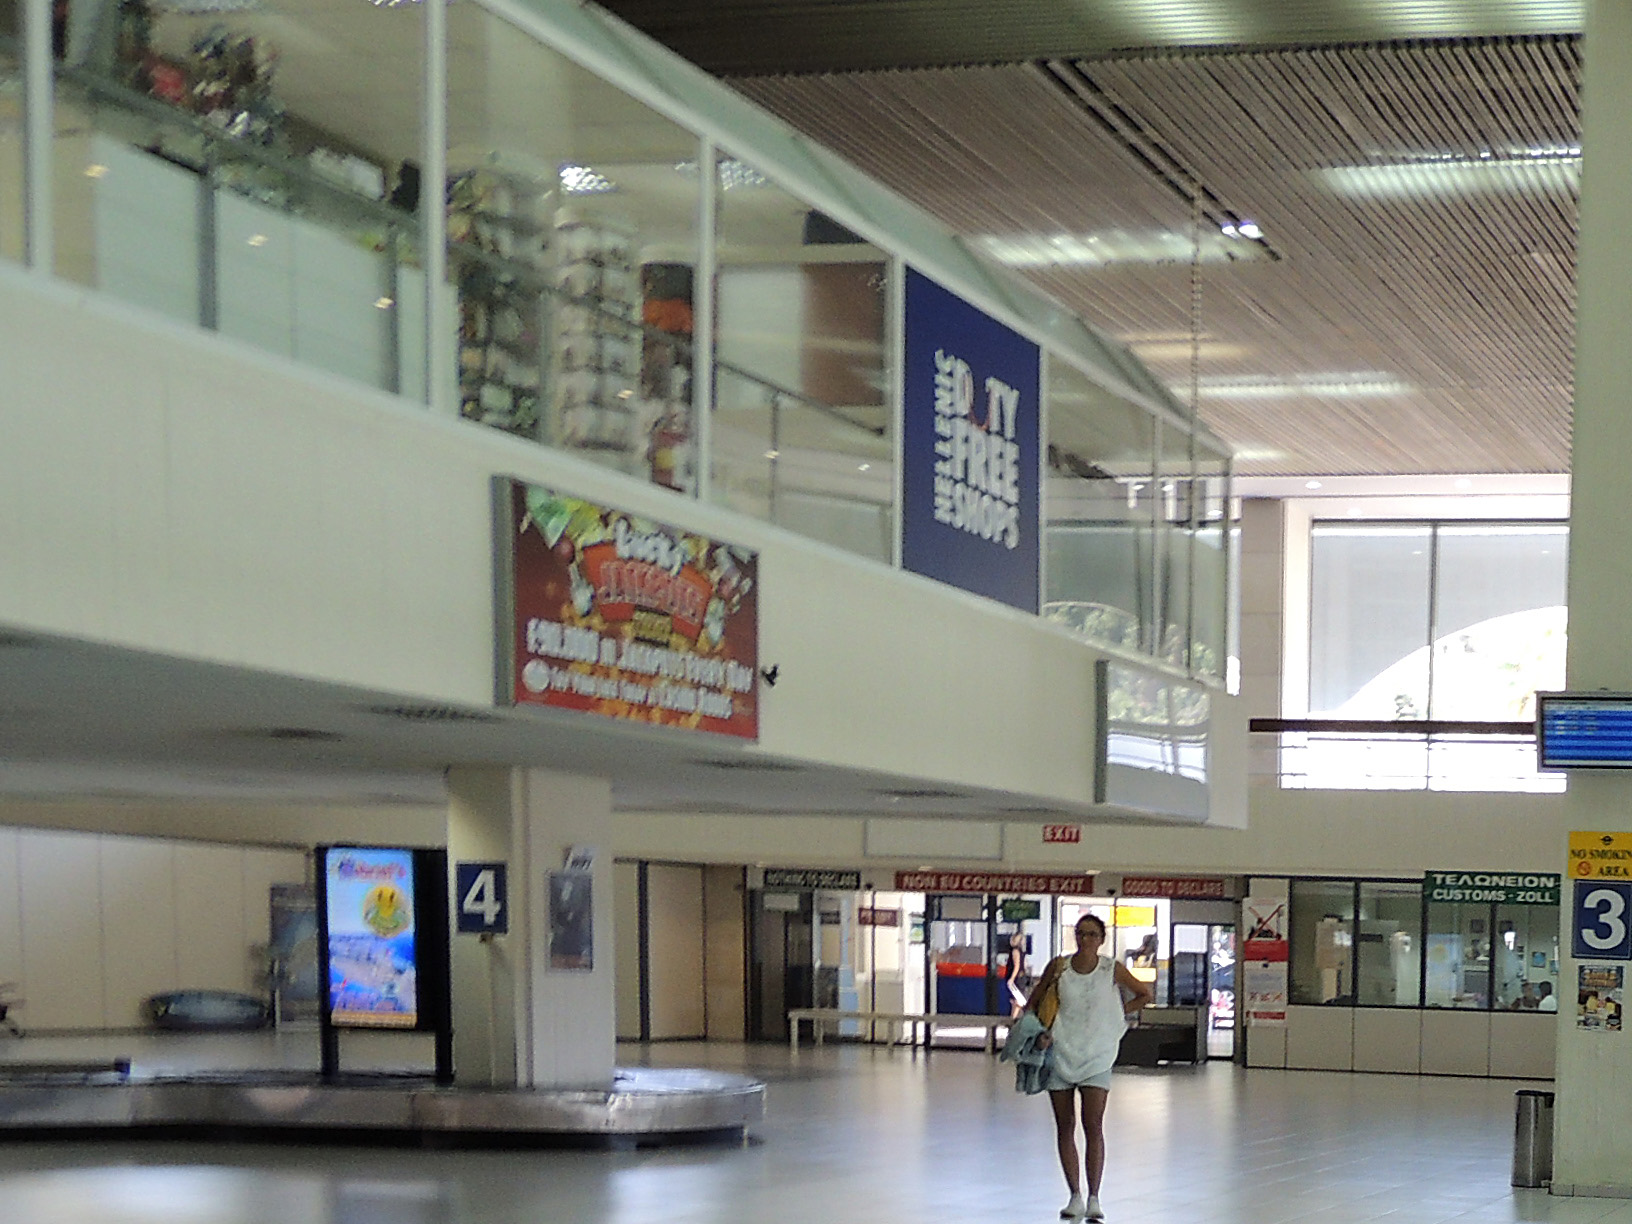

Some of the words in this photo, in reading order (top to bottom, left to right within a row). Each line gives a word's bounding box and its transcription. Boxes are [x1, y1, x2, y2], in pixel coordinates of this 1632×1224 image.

[951, 416, 1020, 505] FREE
[951, 482, 1020, 550] SHOPS
[1044, 827, 1079, 841] EXIT
[1571, 849, 1586, 859] NO
[1598, 866, 1629, 876] AREA
[903, 874, 935, 890] NON
[962, 875, 1046, 892] COUNTRIES
[1050, 877, 1085, 893] EXIT
[1432, 873, 1555, 888] ΤΕΛΩΝΕΙΟΝ
[462, 868, 501, 926] 4
[1432, 888, 1506, 902] CUSTOMS
[1515, 891, 1553, 903] ZOLL
[1581, 889, 1627, 950] 3
